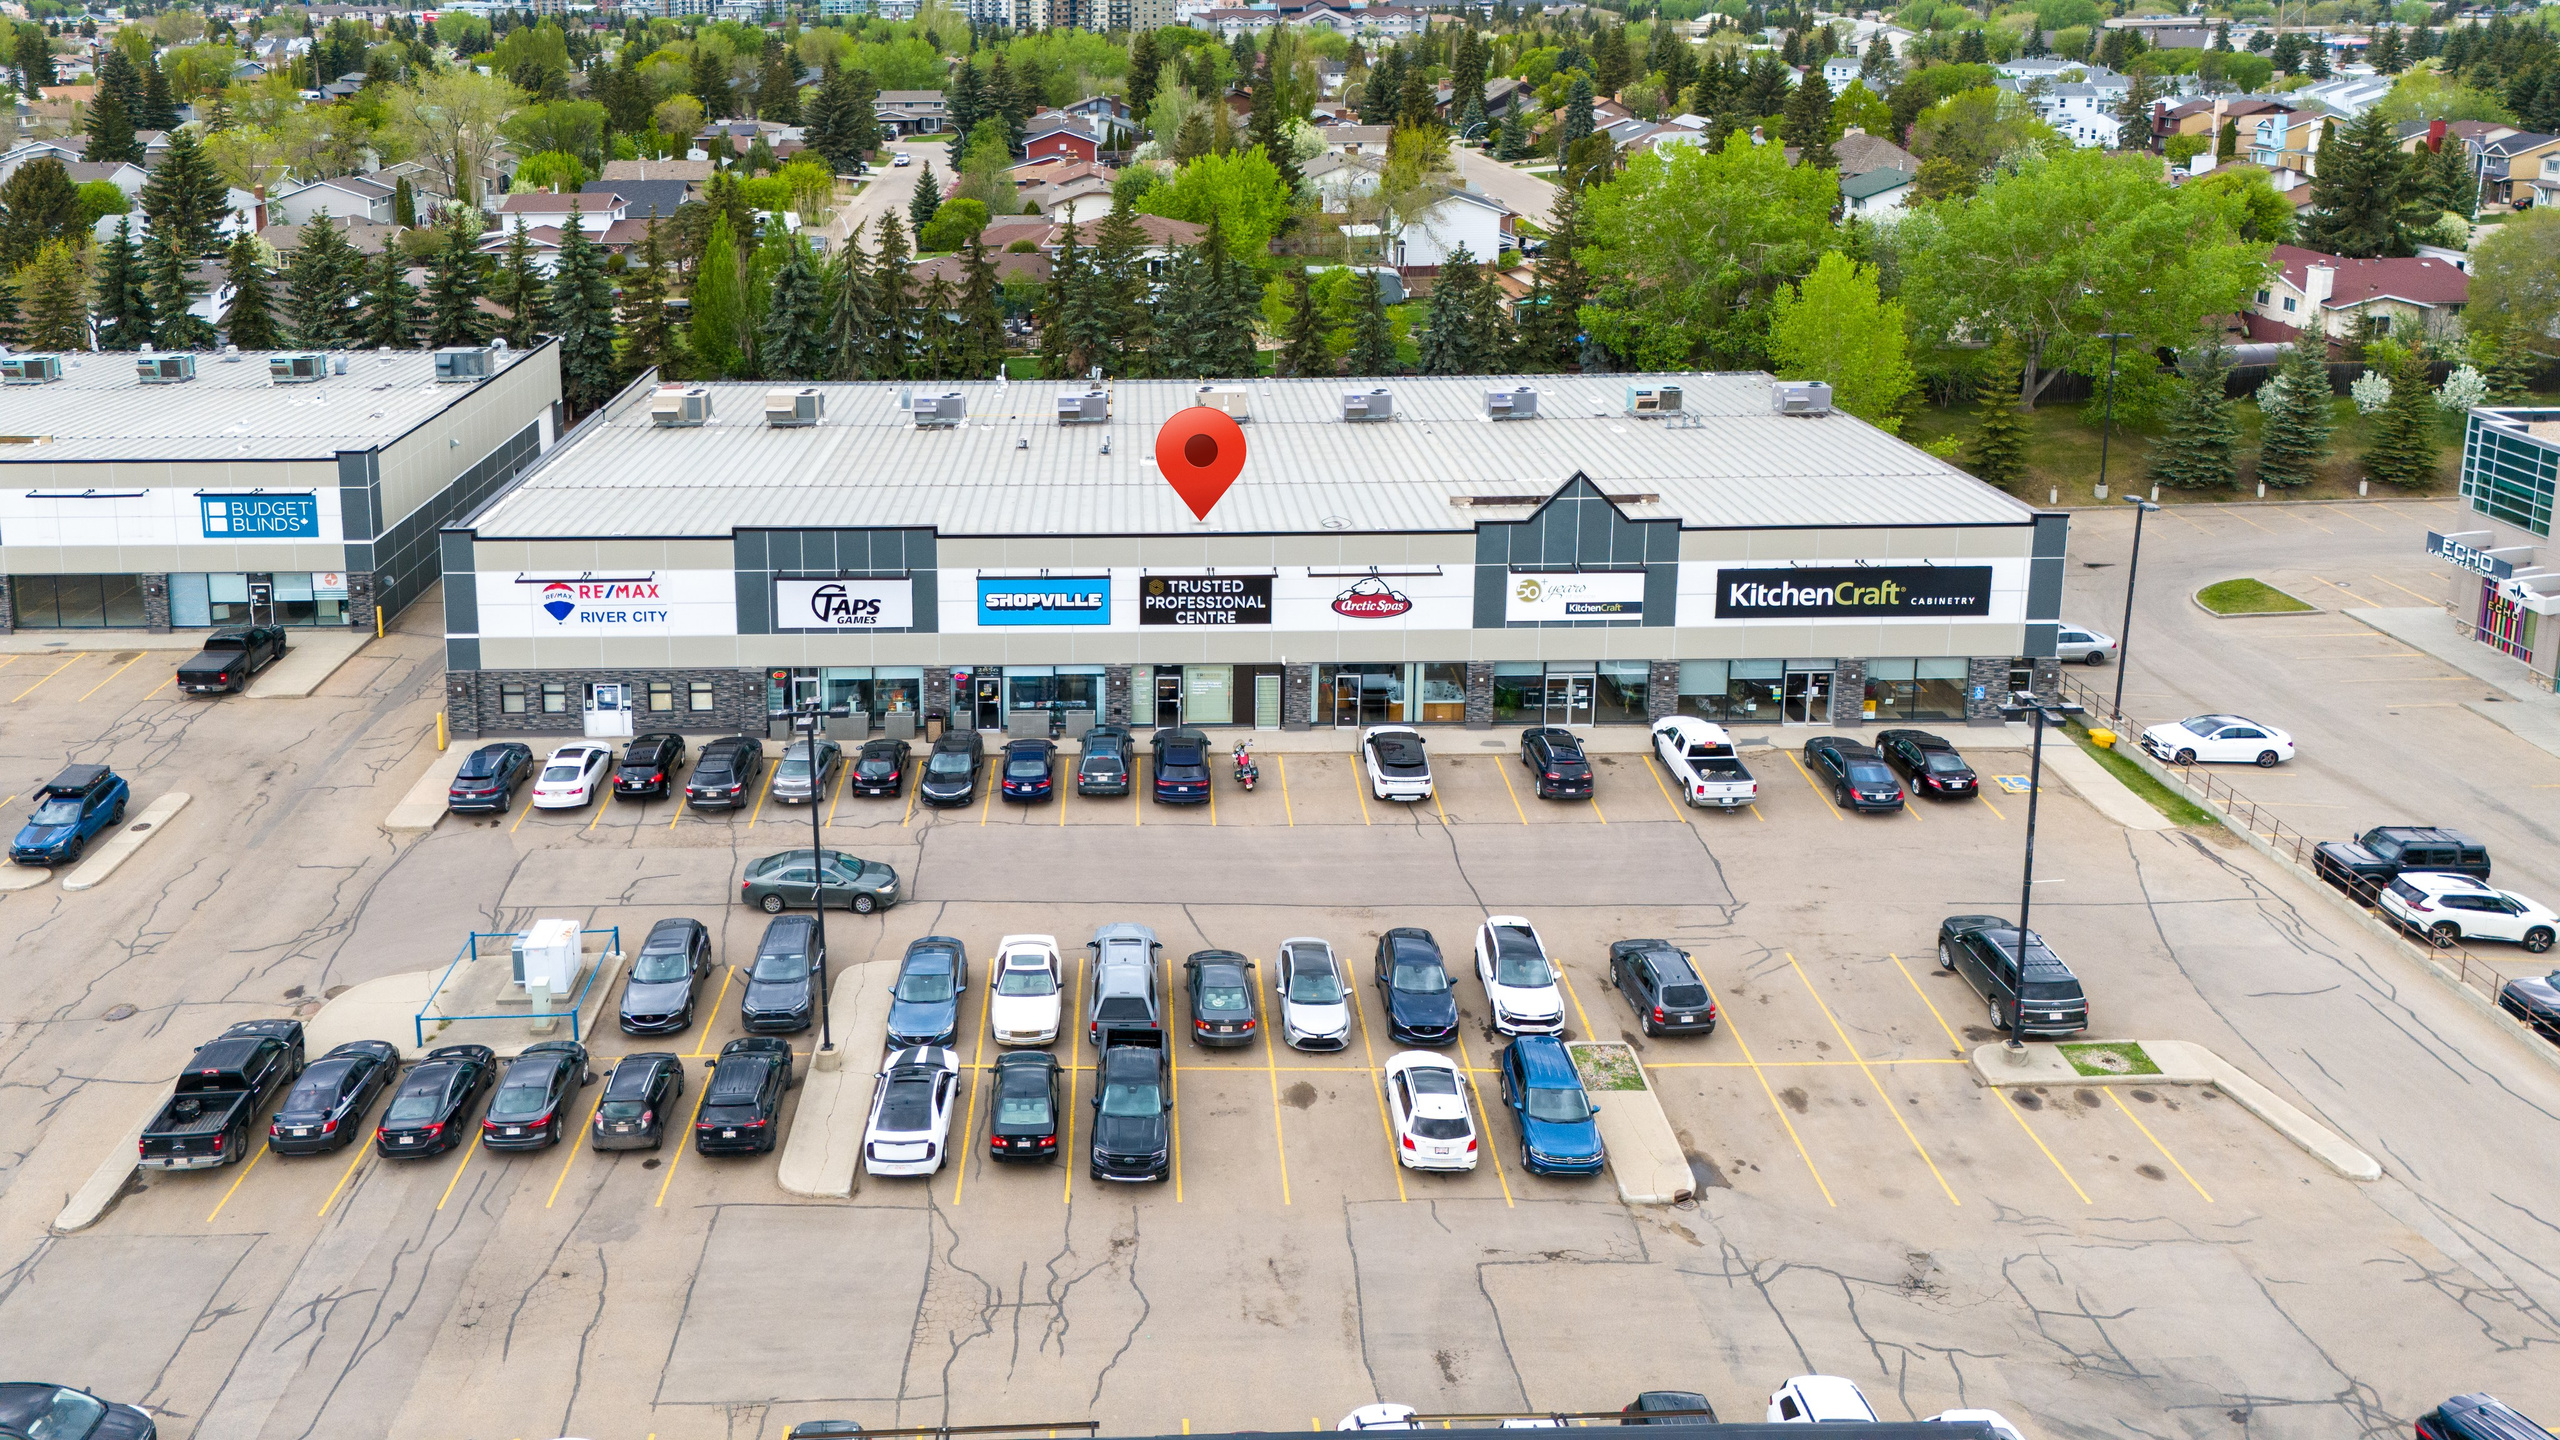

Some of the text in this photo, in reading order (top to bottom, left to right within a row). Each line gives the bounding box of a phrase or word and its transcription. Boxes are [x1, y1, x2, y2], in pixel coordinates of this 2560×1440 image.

[231, 501, 309, 516] BUDGET
[232, 517, 300, 532] BLINDS
[2442, 538, 2494, 572] ECHO
[579, 584, 660, 599] RE/MAX
[1168, 580, 1244, 594] TRUSTED
[545, 592, 573, 600] RE/MAX
[811, 584, 882, 622] TAPS
[985, 593, 1103, 611] SHOPVILLE
[1145, 596, 1266, 609] PROFESSIONAL
[1910, 597, 1976, 606] CABINETRY
[1376, 599, 1405, 613] Spas
[1569, 603, 1622, 612] KitchenCraft
[2487, 600, 2520, 621] ECHO
[580, 611, 668, 623] RIVER CITY
[837, 616, 878, 625] GAMES
[1175, 611, 1237, 624] CENTRE
